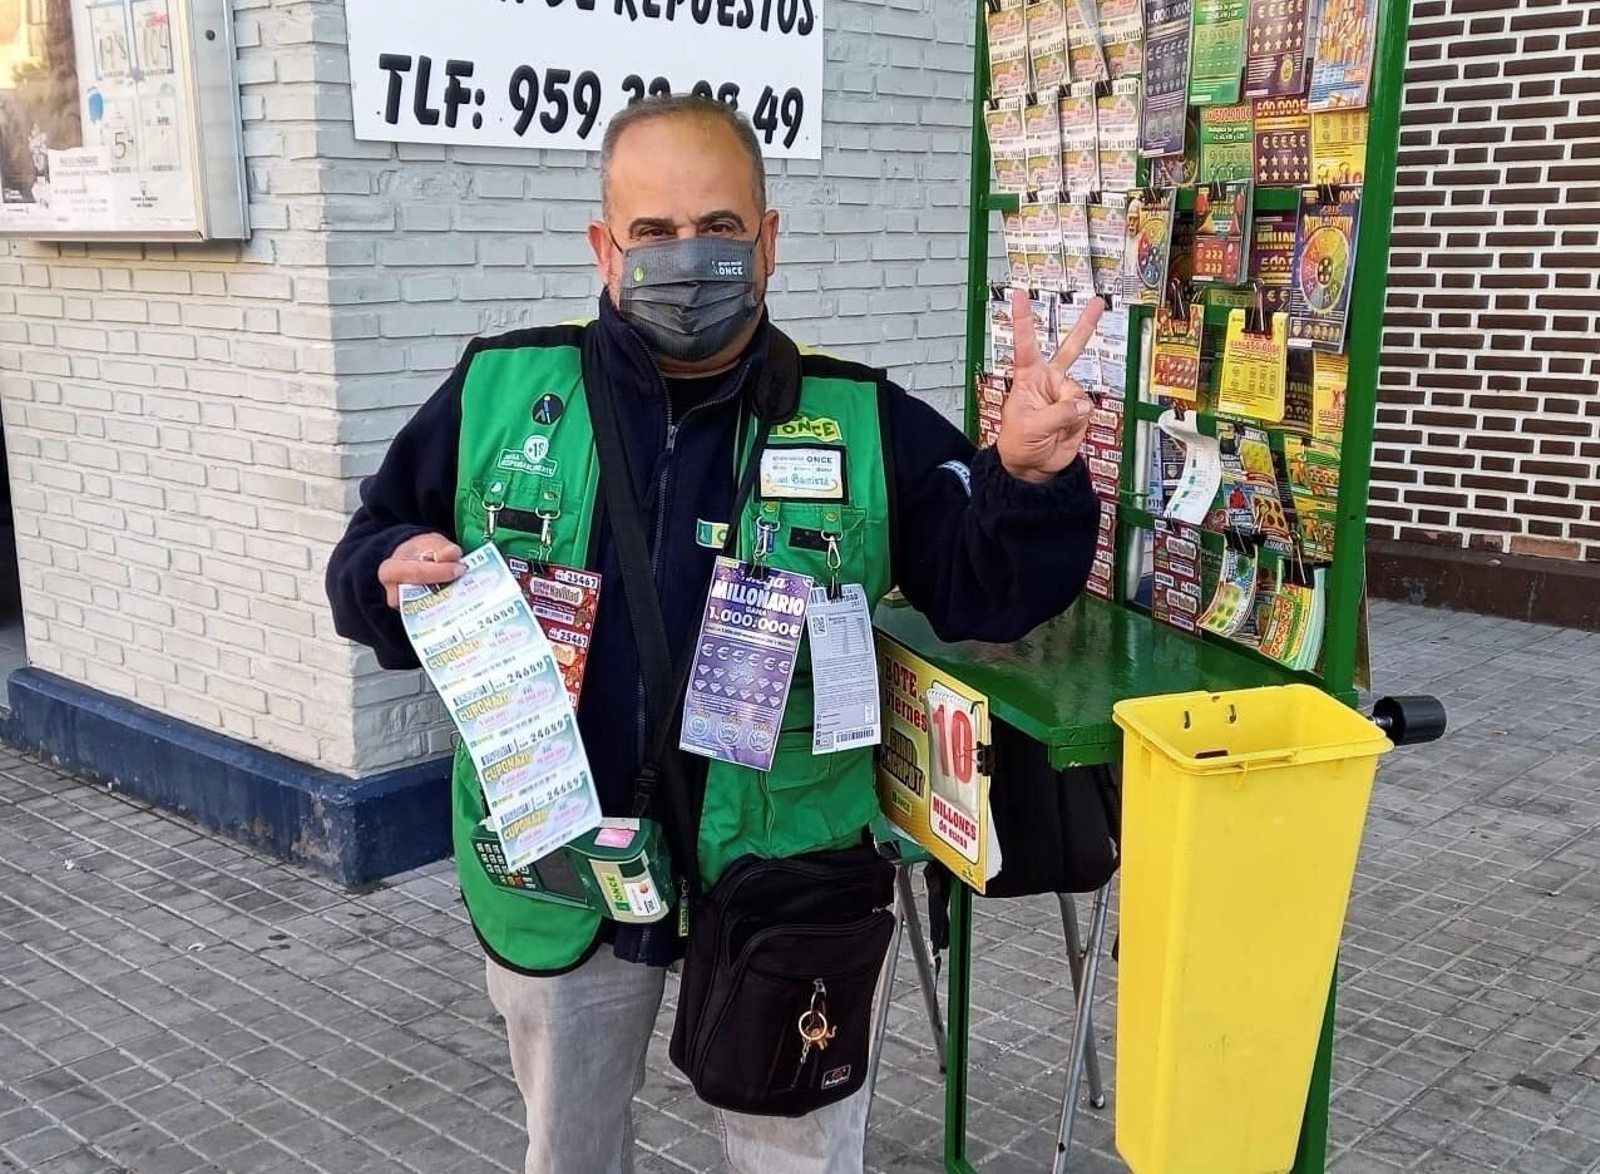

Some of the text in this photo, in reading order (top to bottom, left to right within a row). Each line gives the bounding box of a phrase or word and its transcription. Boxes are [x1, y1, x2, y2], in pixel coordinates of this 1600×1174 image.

[378, 53, 485, 129] TLF:
[508, 64, 600, 140] 959
[753, 85, 804, 149] 49
[783, 420, 835, 437] ONCE
[806, 456, 833, 464] ONCE
[567, 572, 596, 587] 25467
[711, 580, 805, 616] MILLONARIO
[560, 631, 587, 647] 25467
[709, 606, 801, 638] 1.000.000€
[885, 656, 918, 700] BOTE
[933, 704, 972, 784] 10
[932, 796, 977, 841] MILLONES
